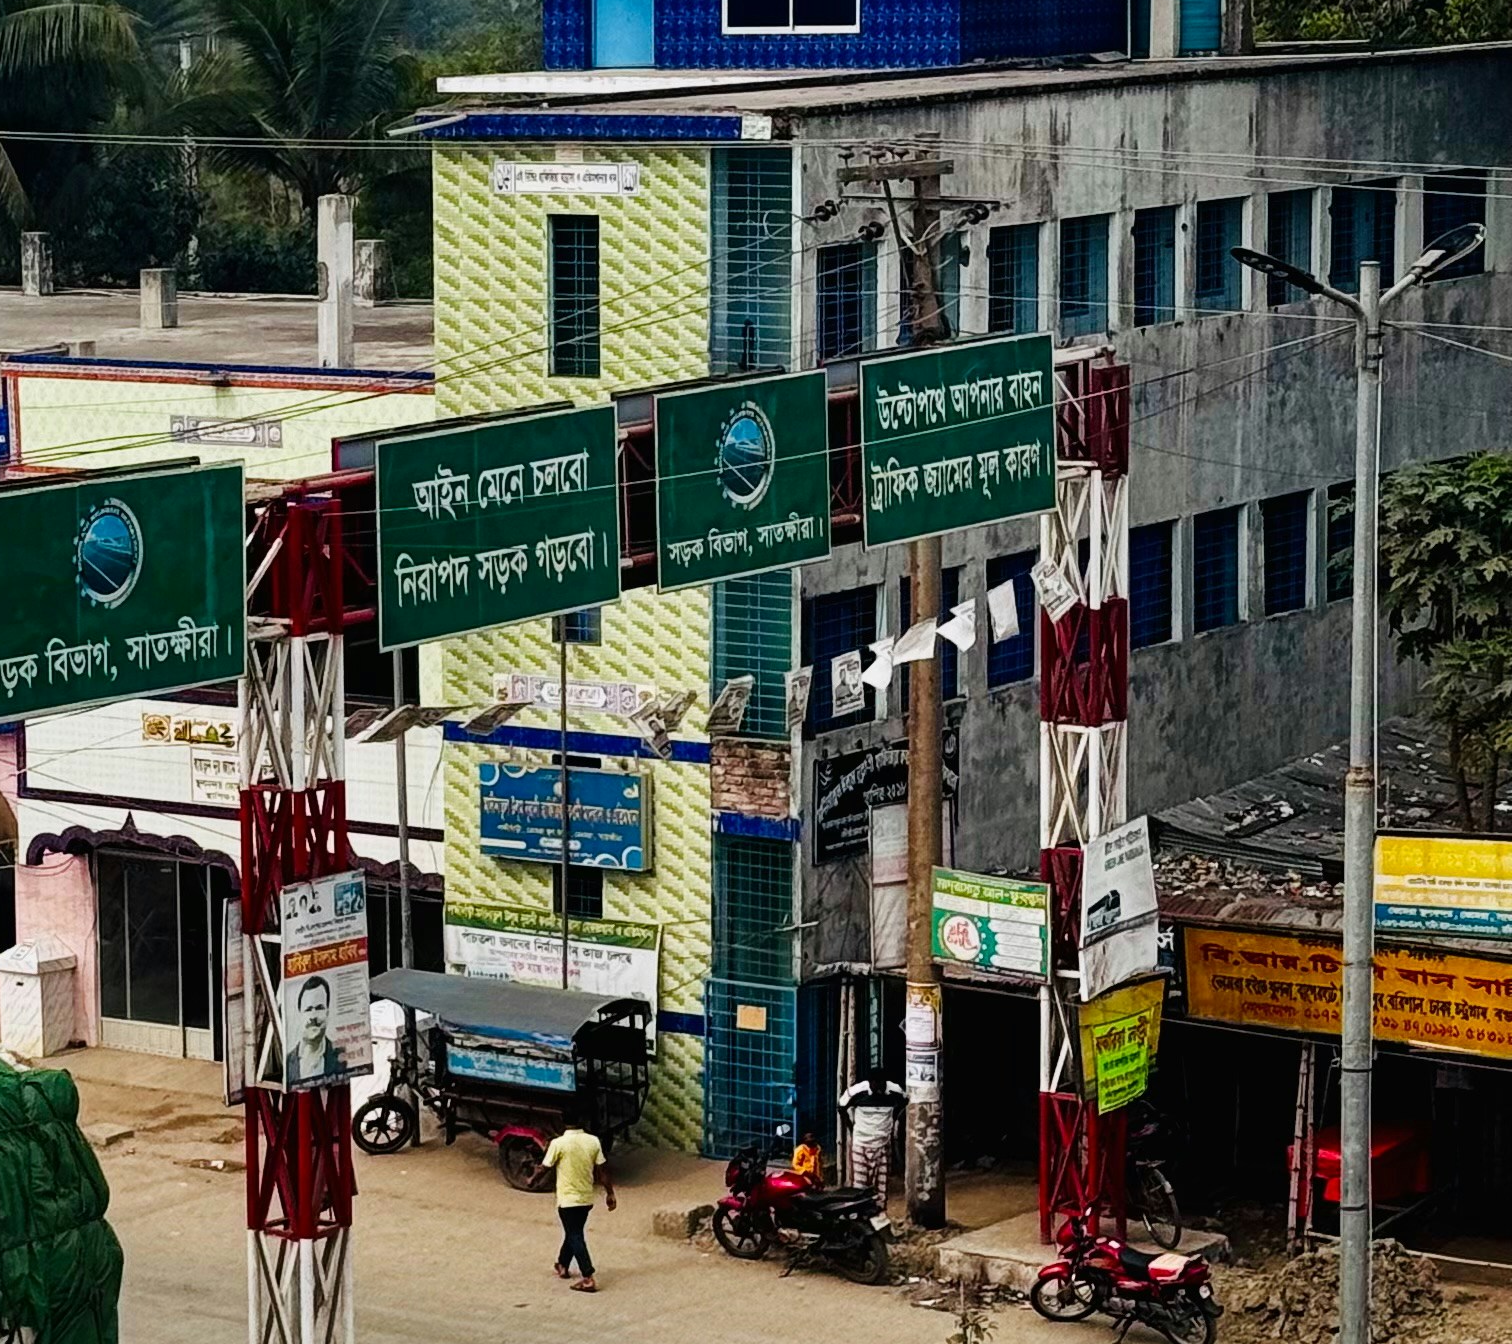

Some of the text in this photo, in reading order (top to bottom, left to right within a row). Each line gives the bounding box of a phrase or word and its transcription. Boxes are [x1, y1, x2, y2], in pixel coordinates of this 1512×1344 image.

[951, 378, 1005, 417] আপনার
[1009, 367, 1044, 412] বাহন
[411, 447, 589, 522] আইন মেনে চলবো
[869, 462, 920, 513] ট্রাফিক
[923, 454, 975, 501] জ্যামের
[977, 453, 1000, 501] মূল
[394, 553, 471, 609] নিরাপদ
[477, 543, 531, 595] সড়ক
[666, 537, 703, 568] সড়ক
[1394, 966, 1458, 990] বাস
